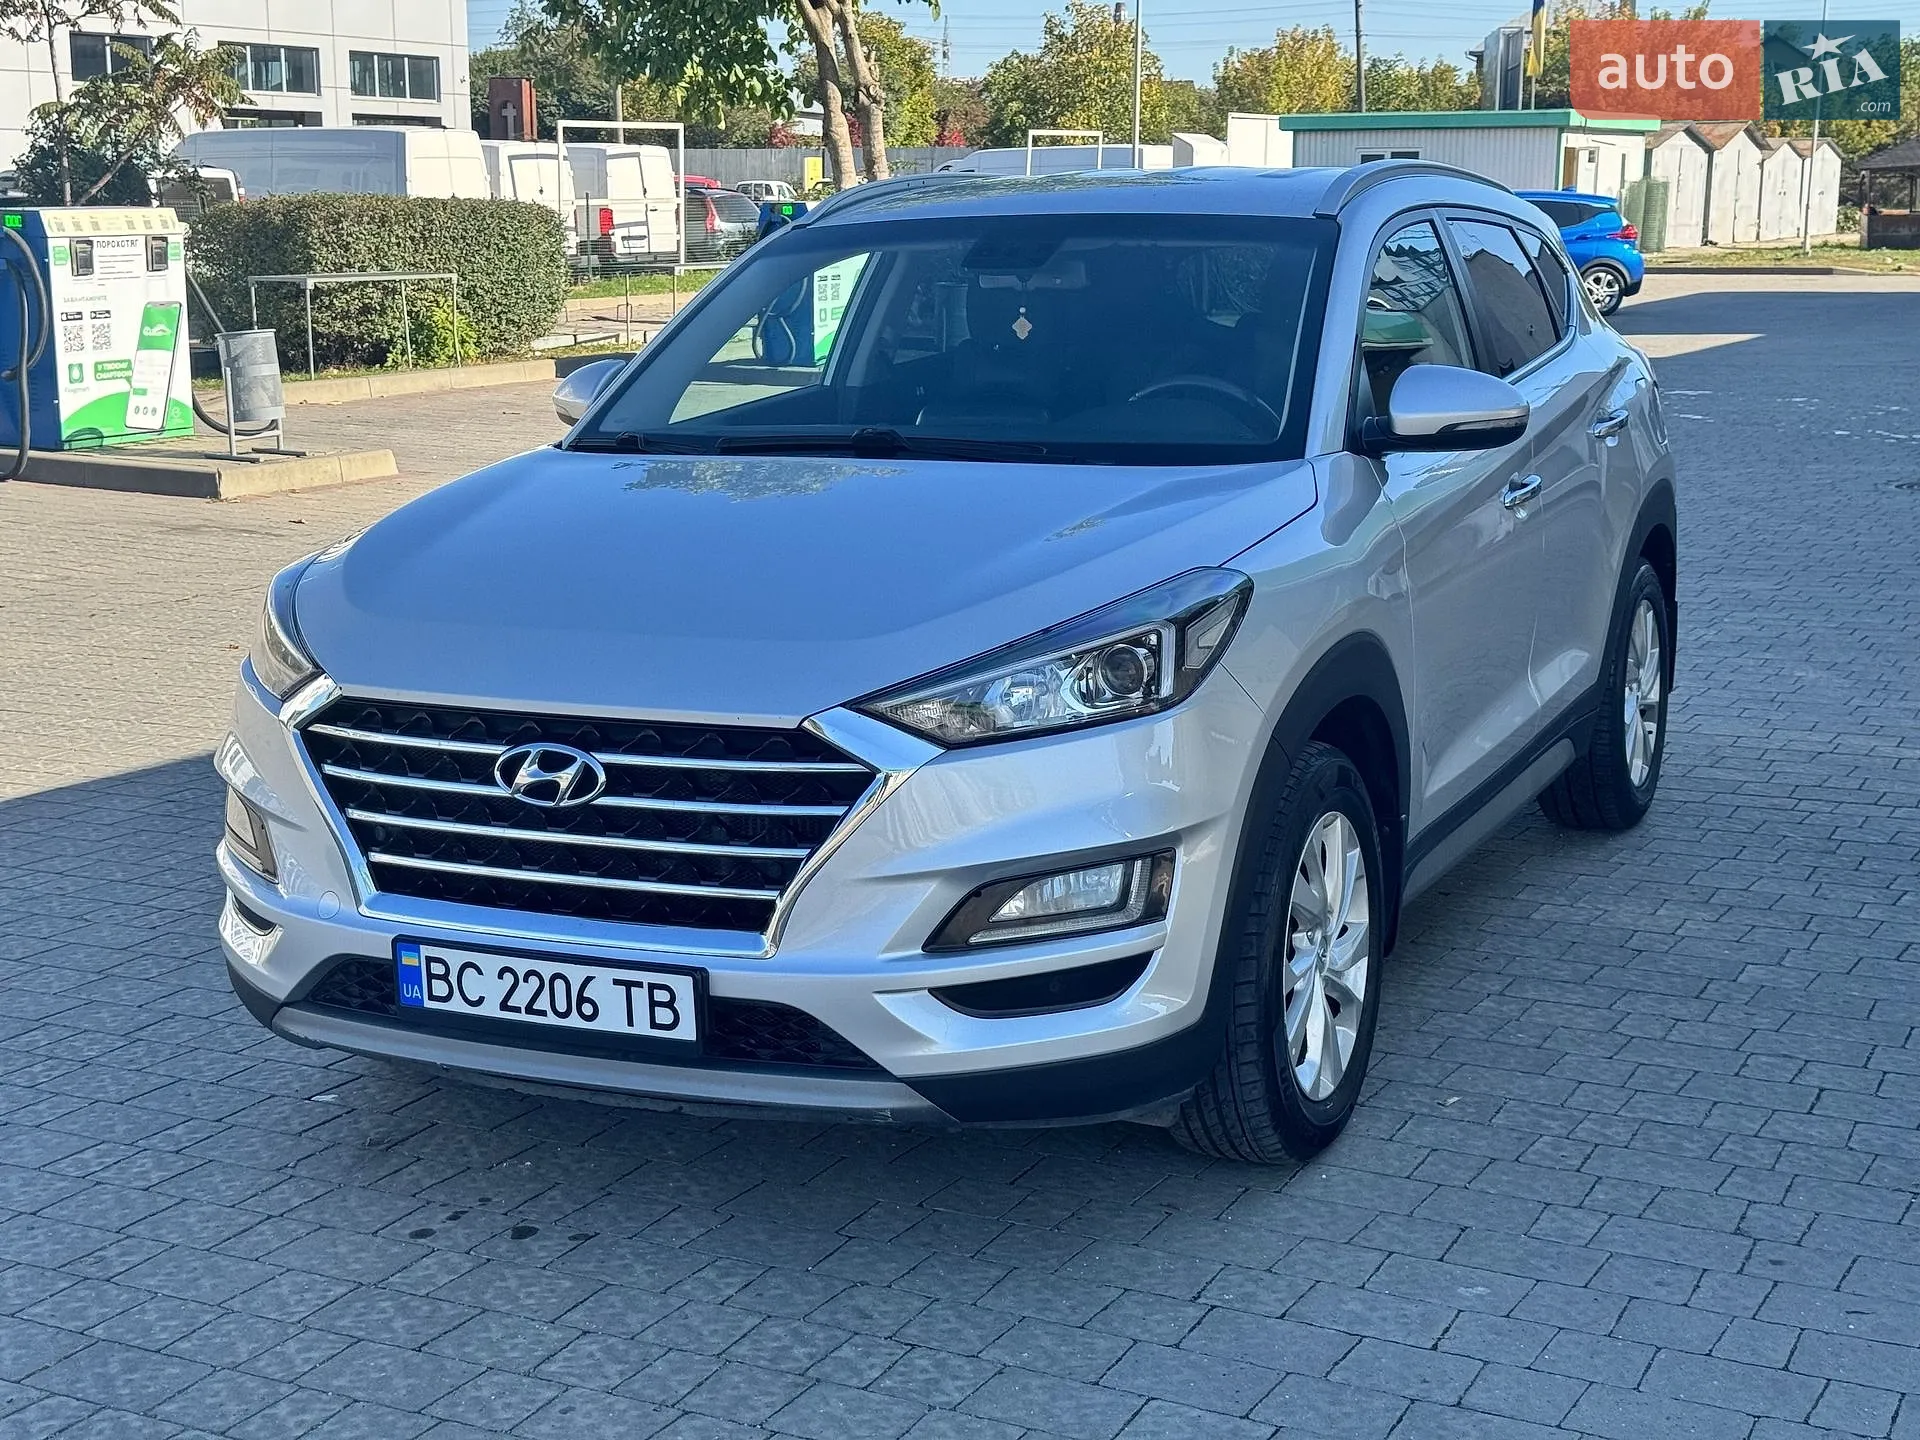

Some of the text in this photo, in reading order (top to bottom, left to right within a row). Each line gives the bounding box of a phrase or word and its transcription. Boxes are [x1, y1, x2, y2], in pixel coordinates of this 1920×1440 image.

[96, 239, 139, 248] ПОРОХОТЯГ
[403, 983, 422, 999] UA
[425, 955, 681, 1031] BC 2206 TB
